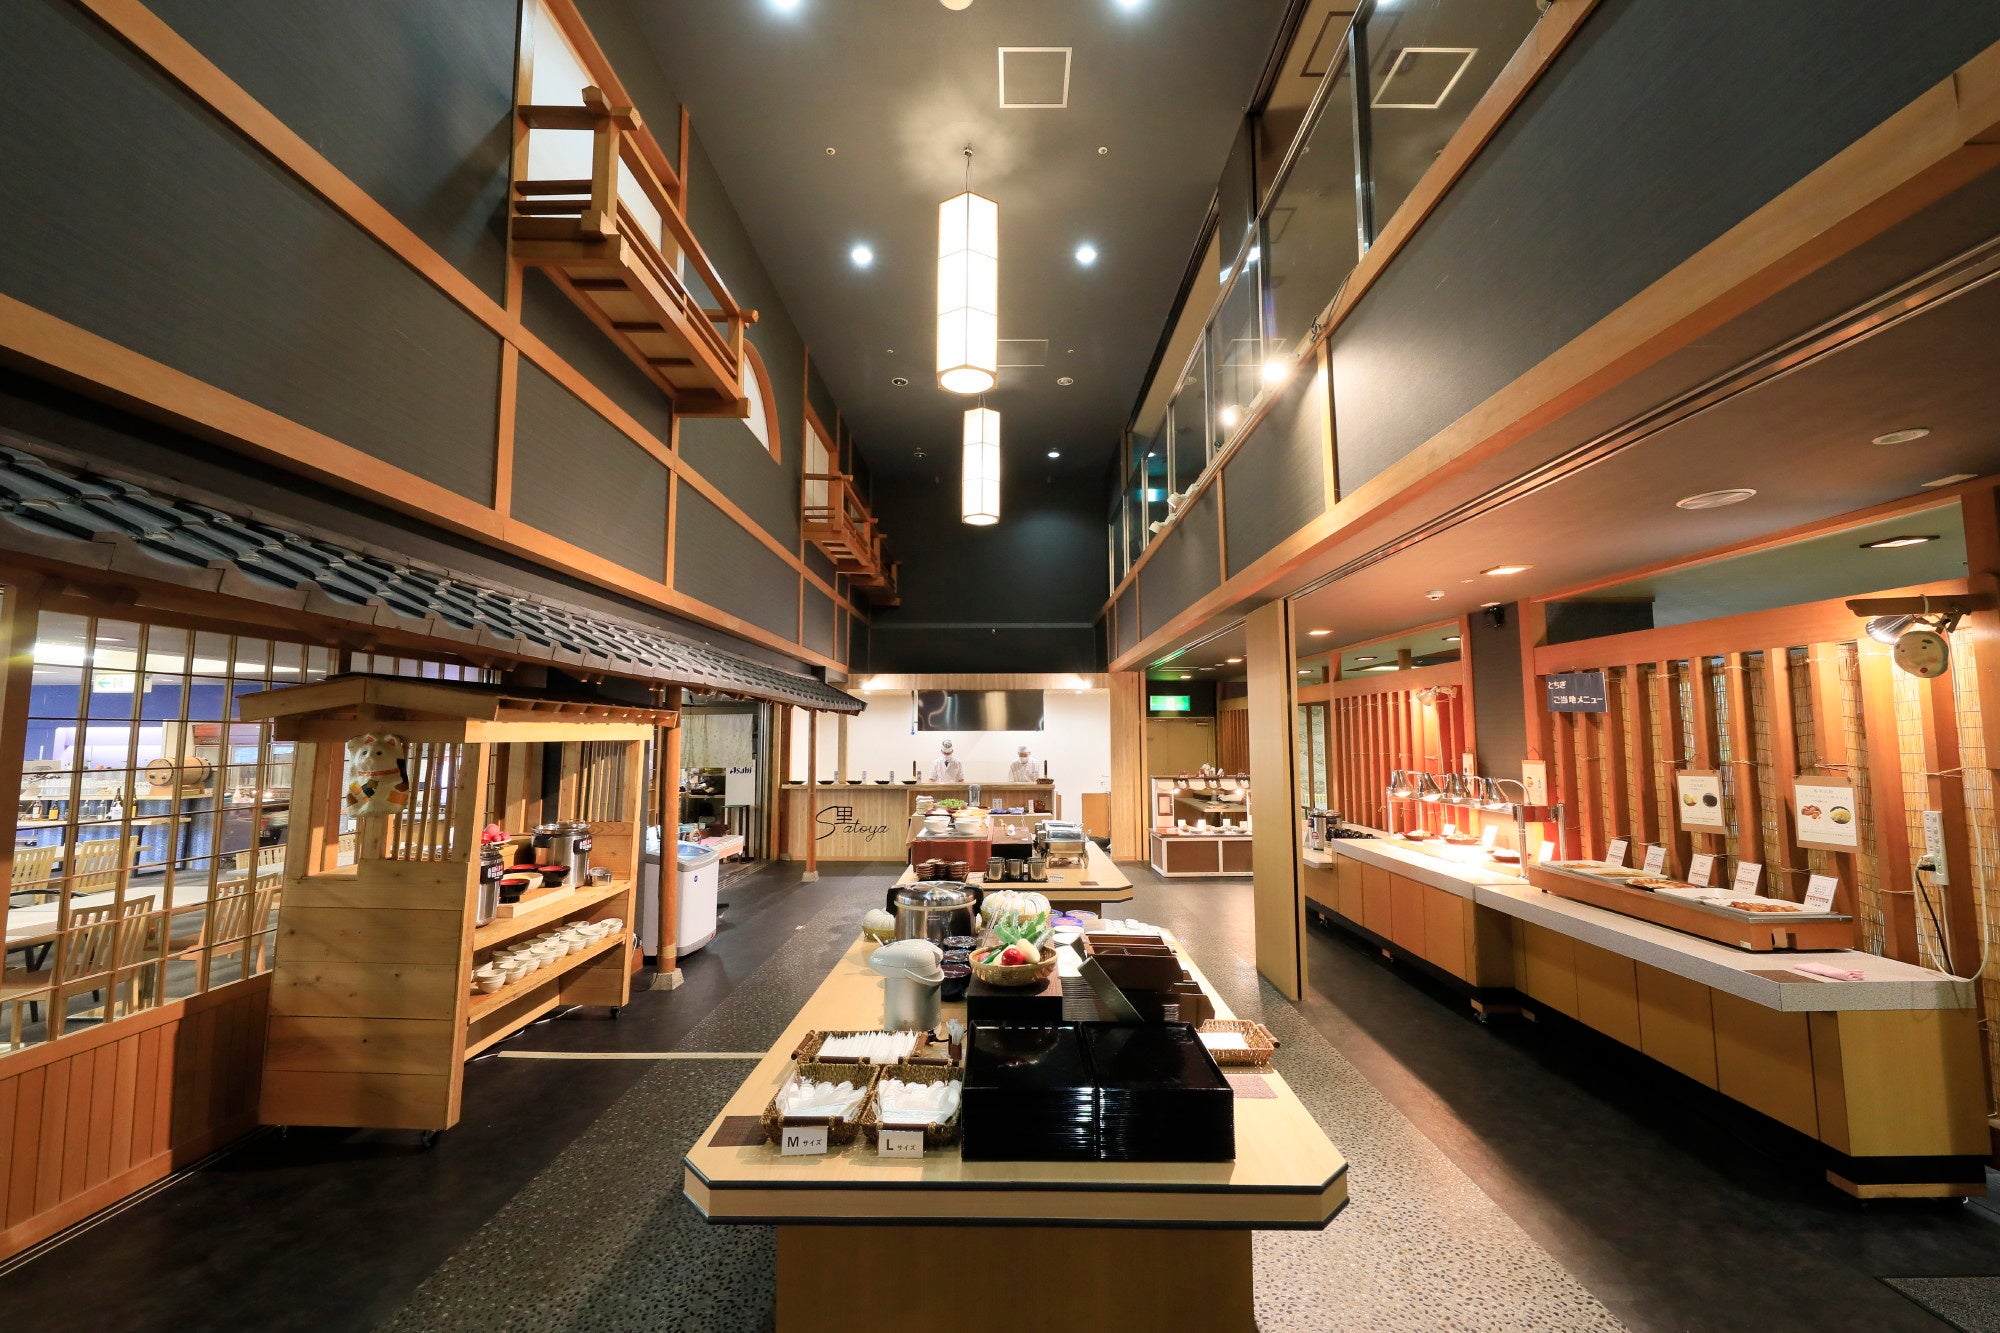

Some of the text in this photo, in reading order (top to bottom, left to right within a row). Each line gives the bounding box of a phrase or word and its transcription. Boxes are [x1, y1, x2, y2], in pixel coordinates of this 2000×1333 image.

[1548, 680, 1567, 690] とちぎ
[1553, 695, 1604, 704] ご当地メニュー
[729, 766, 752, 775] Asahi
[815, 805, 889, 843] Satoya
[787, 1136, 823, 1148] M サイズ
[886, 1138, 916, 1152] L サイズ
